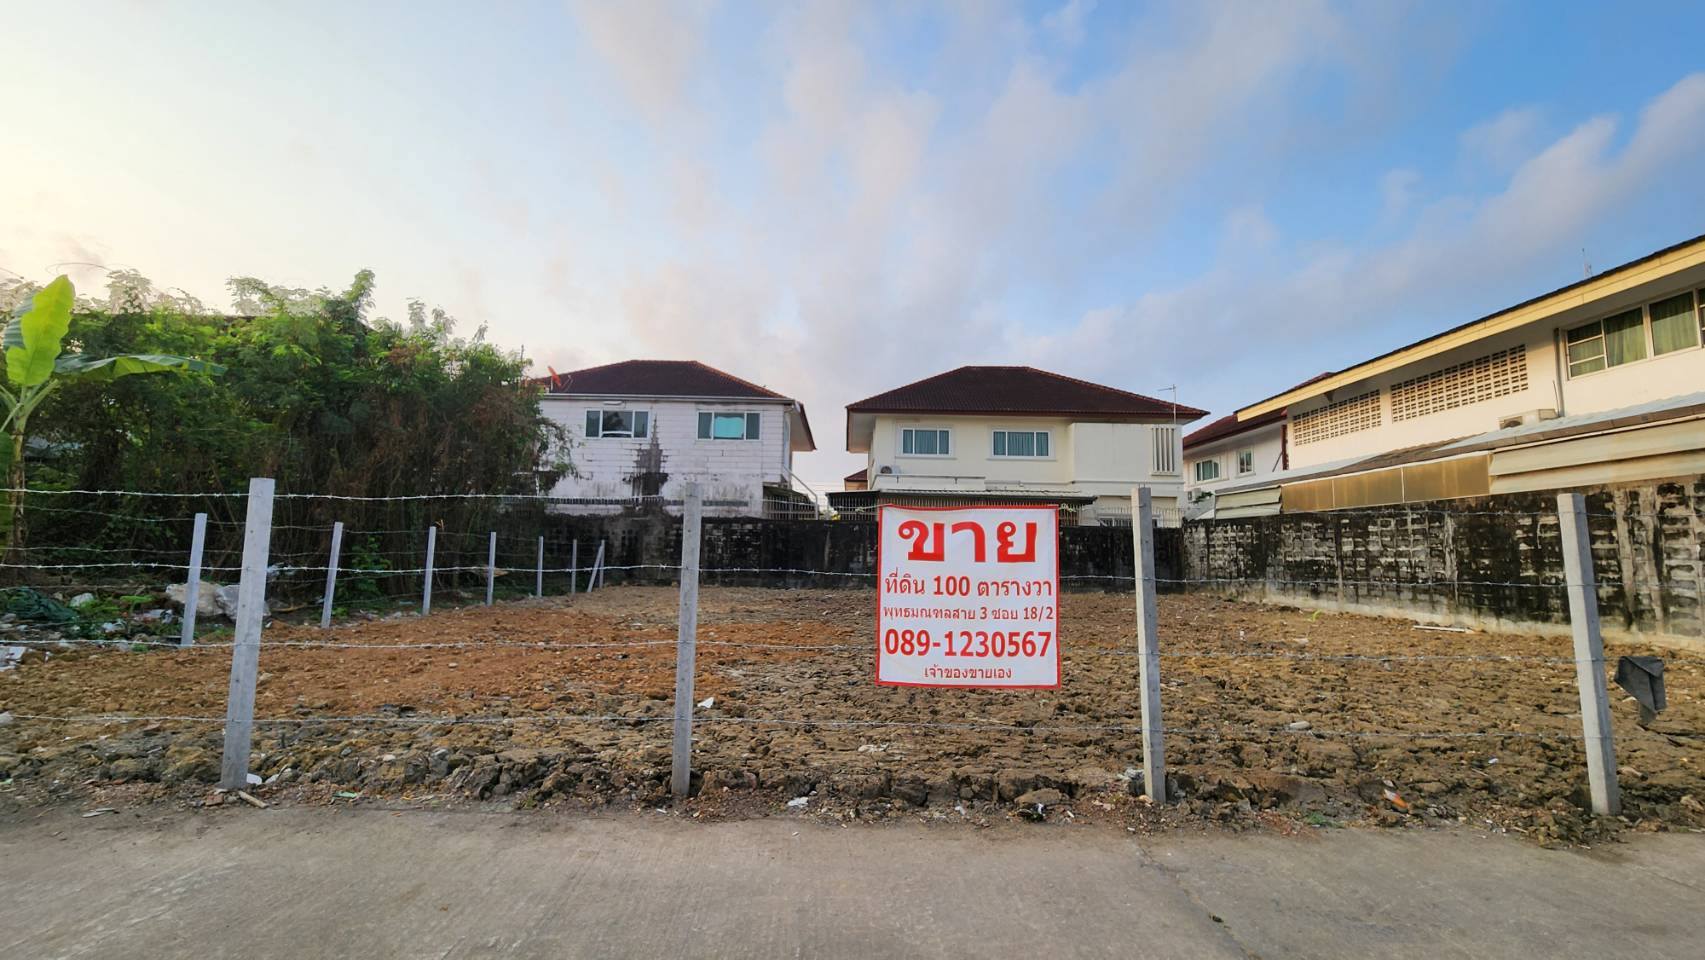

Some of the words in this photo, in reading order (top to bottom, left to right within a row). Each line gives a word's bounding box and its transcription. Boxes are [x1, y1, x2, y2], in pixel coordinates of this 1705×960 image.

[898, 520, 1037, 563] ขาย
[885, 568, 925, 595] ที่ดิน
[933, 576, 970, 596] 100
[977, 580, 1052, 597] ตารางวา
[980, 607, 988, 620] 3
[1023, 606, 1053, 622] 18/2
[885, 628, 1052, 658] 089-1230567
[925, 664, 1012, 679] เจ้าของขายเอง
